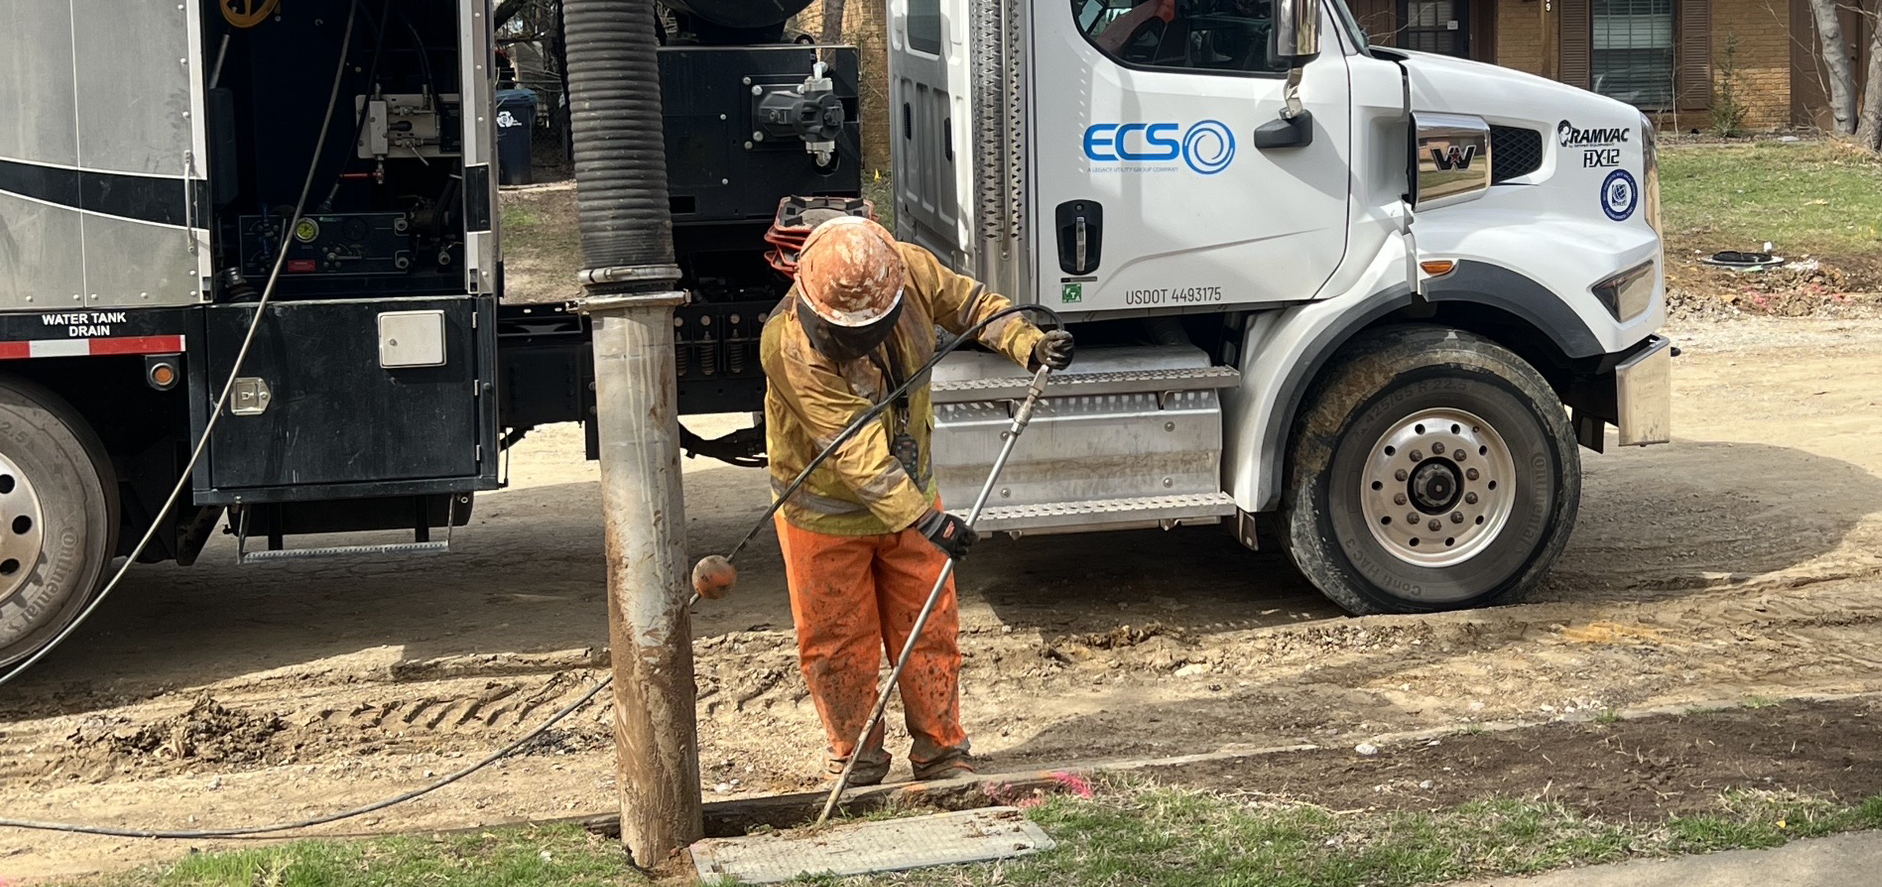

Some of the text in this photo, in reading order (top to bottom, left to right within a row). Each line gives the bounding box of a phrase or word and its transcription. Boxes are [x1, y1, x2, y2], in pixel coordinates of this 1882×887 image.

[1569, 127, 1630, 144] RAMVAC
[1583, 148, 1620, 168] HX-12
[1126, 286, 1221, 305] USDOT 4493175
[42, 312, 126, 325] WATER TANK
[68, 325, 110, 336] DRAIN
[20, 526, 79, 625] Continental
